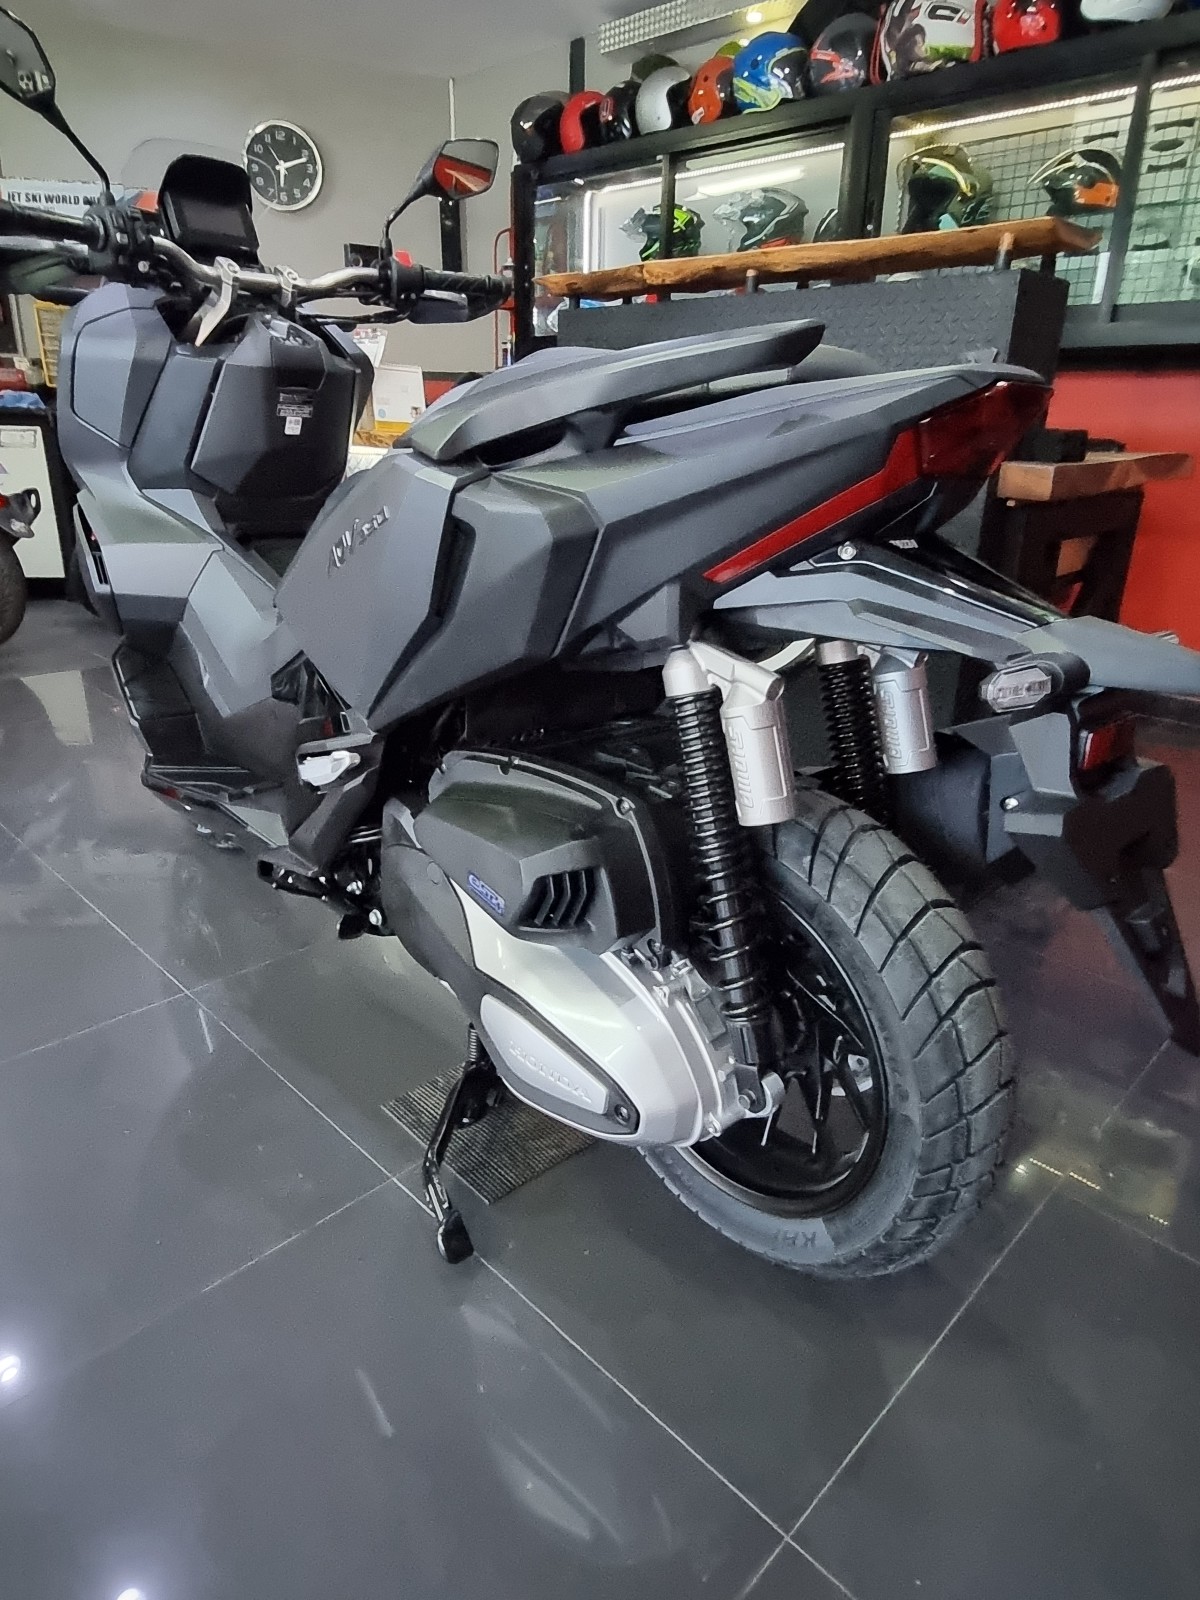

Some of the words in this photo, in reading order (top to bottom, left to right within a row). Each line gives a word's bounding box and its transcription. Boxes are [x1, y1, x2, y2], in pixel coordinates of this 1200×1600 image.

[275, 130, 286, 141] 12
[254, 144, 264, 154] 10
[251, 163, 259, 172] 9
[306, 164, 313, 174] 3
[255, 176, 264, 186] 8
[302, 178, 311, 188] 4
[267, 187, 275, 197] 7
[280, 191, 288, 202] 6
[293, 188, 302, 198] 5
[24, 192, 42, 203] SKI
[44, 193, 80, 205] WORLD
